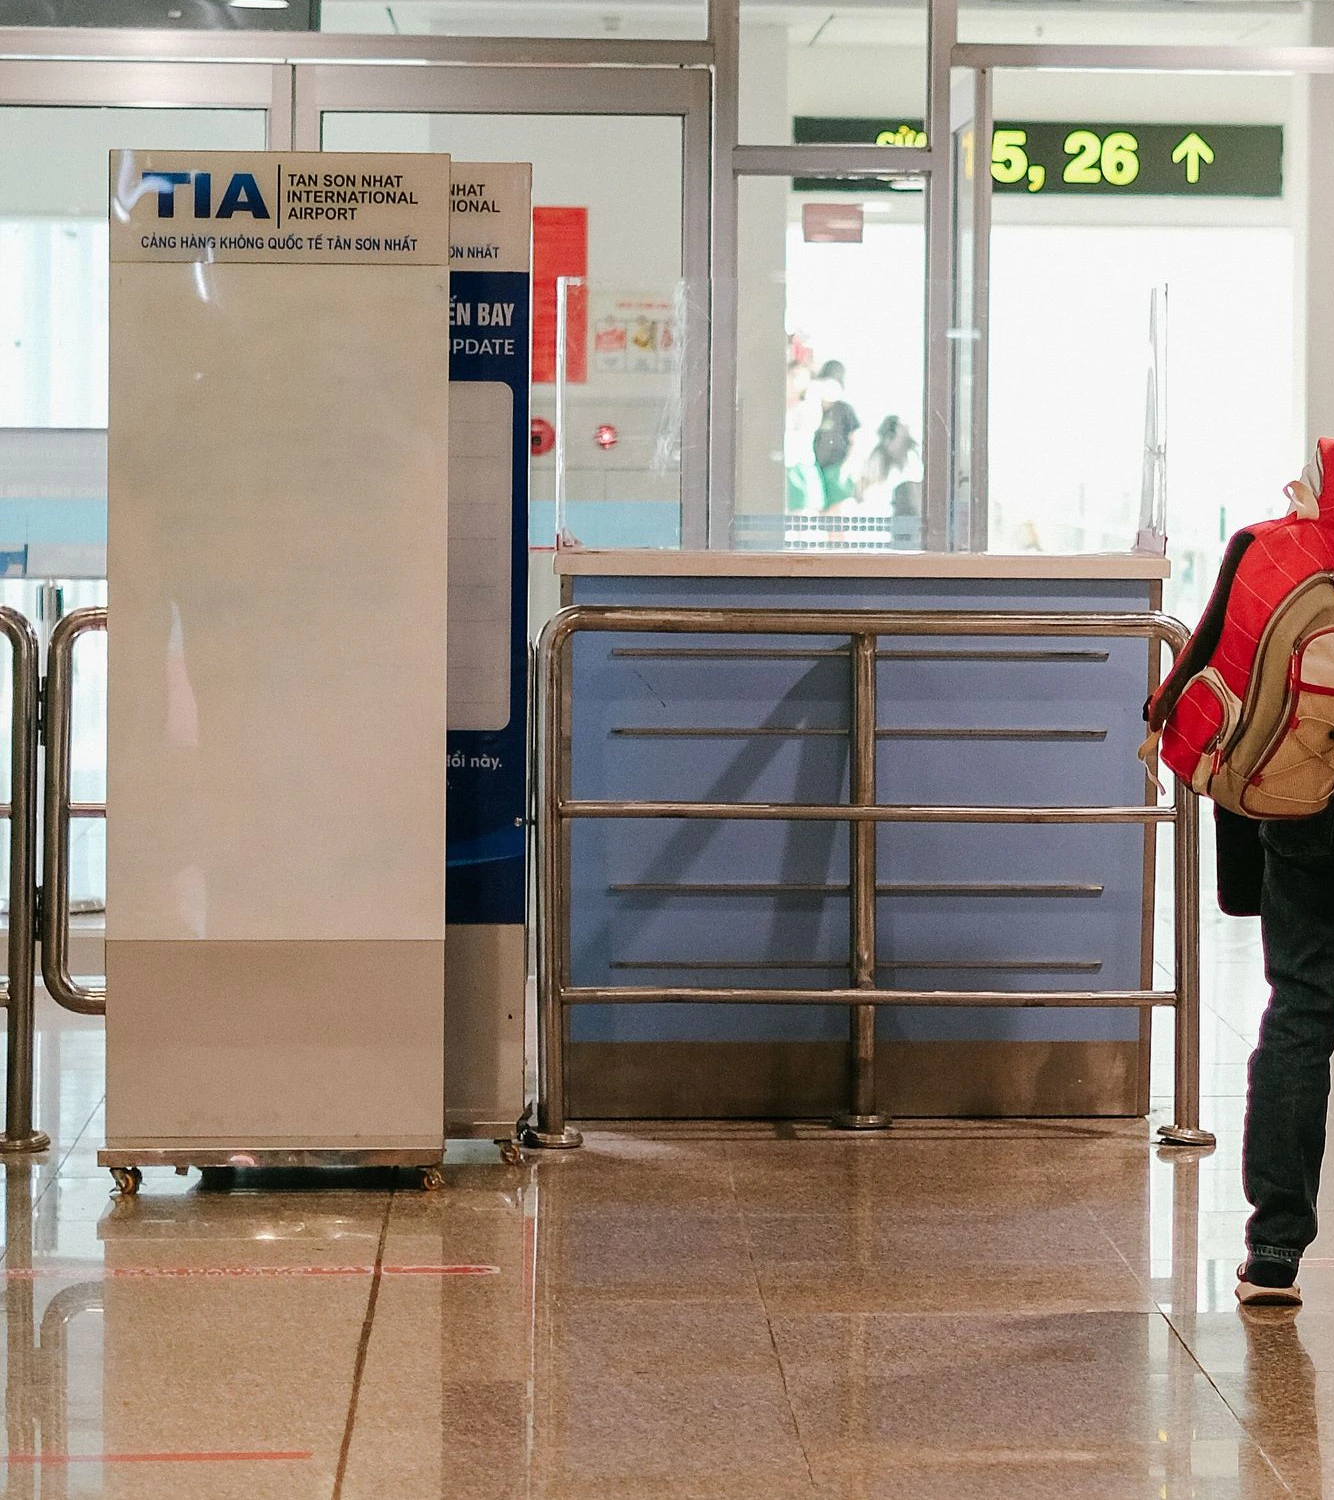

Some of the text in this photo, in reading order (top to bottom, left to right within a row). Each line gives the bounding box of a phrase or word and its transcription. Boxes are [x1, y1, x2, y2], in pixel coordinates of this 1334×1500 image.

[1063, 129, 1140, 186] 26
[288, 174, 403, 188] TAN SON NHAT
[142, 172, 271, 219] TIA
[287, 190, 418, 204] INTERNATIONAL
[288, 207, 357, 220] AIRPORT
[141, 232, 418, 251] CẢNG HÀNG KHÔNG QUỐC TẾ TÂN SƠN NHẤT
[467, 243, 500, 259] NHẤT
[477, 302, 515, 327] BAY
[450, 338, 515, 355] PDATE
[470, 753, 503, 771] này.
